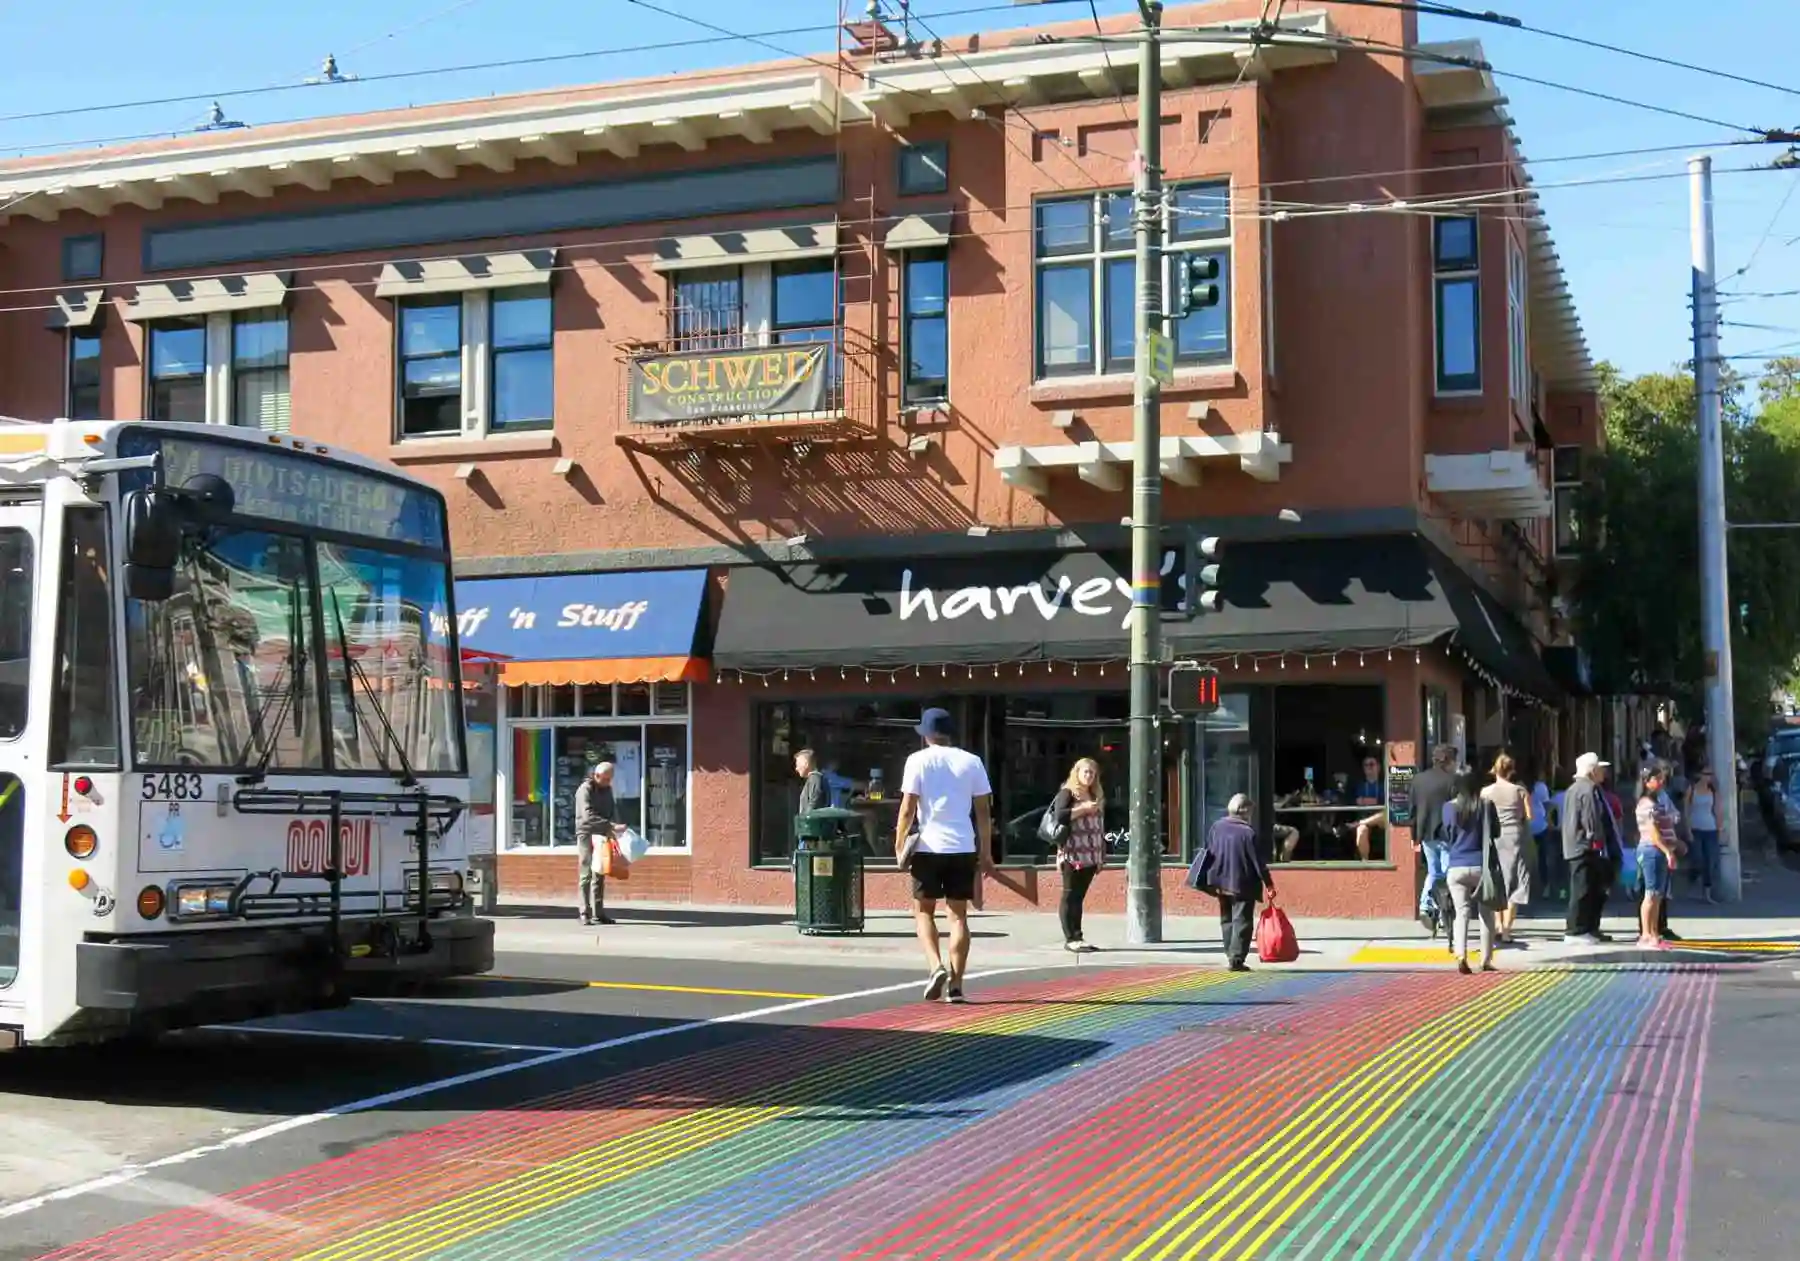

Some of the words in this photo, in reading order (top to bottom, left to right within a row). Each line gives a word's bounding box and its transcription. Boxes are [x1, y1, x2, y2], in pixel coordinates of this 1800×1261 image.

[642, 351, 814, 394] SCHWED
[667, 388, 783, 406] CONSTRUCTION
[557, 600, 649, 631] Stuff
[1199, 676, 1218, 704] 11
[142, 773, 202, 799] 5483
